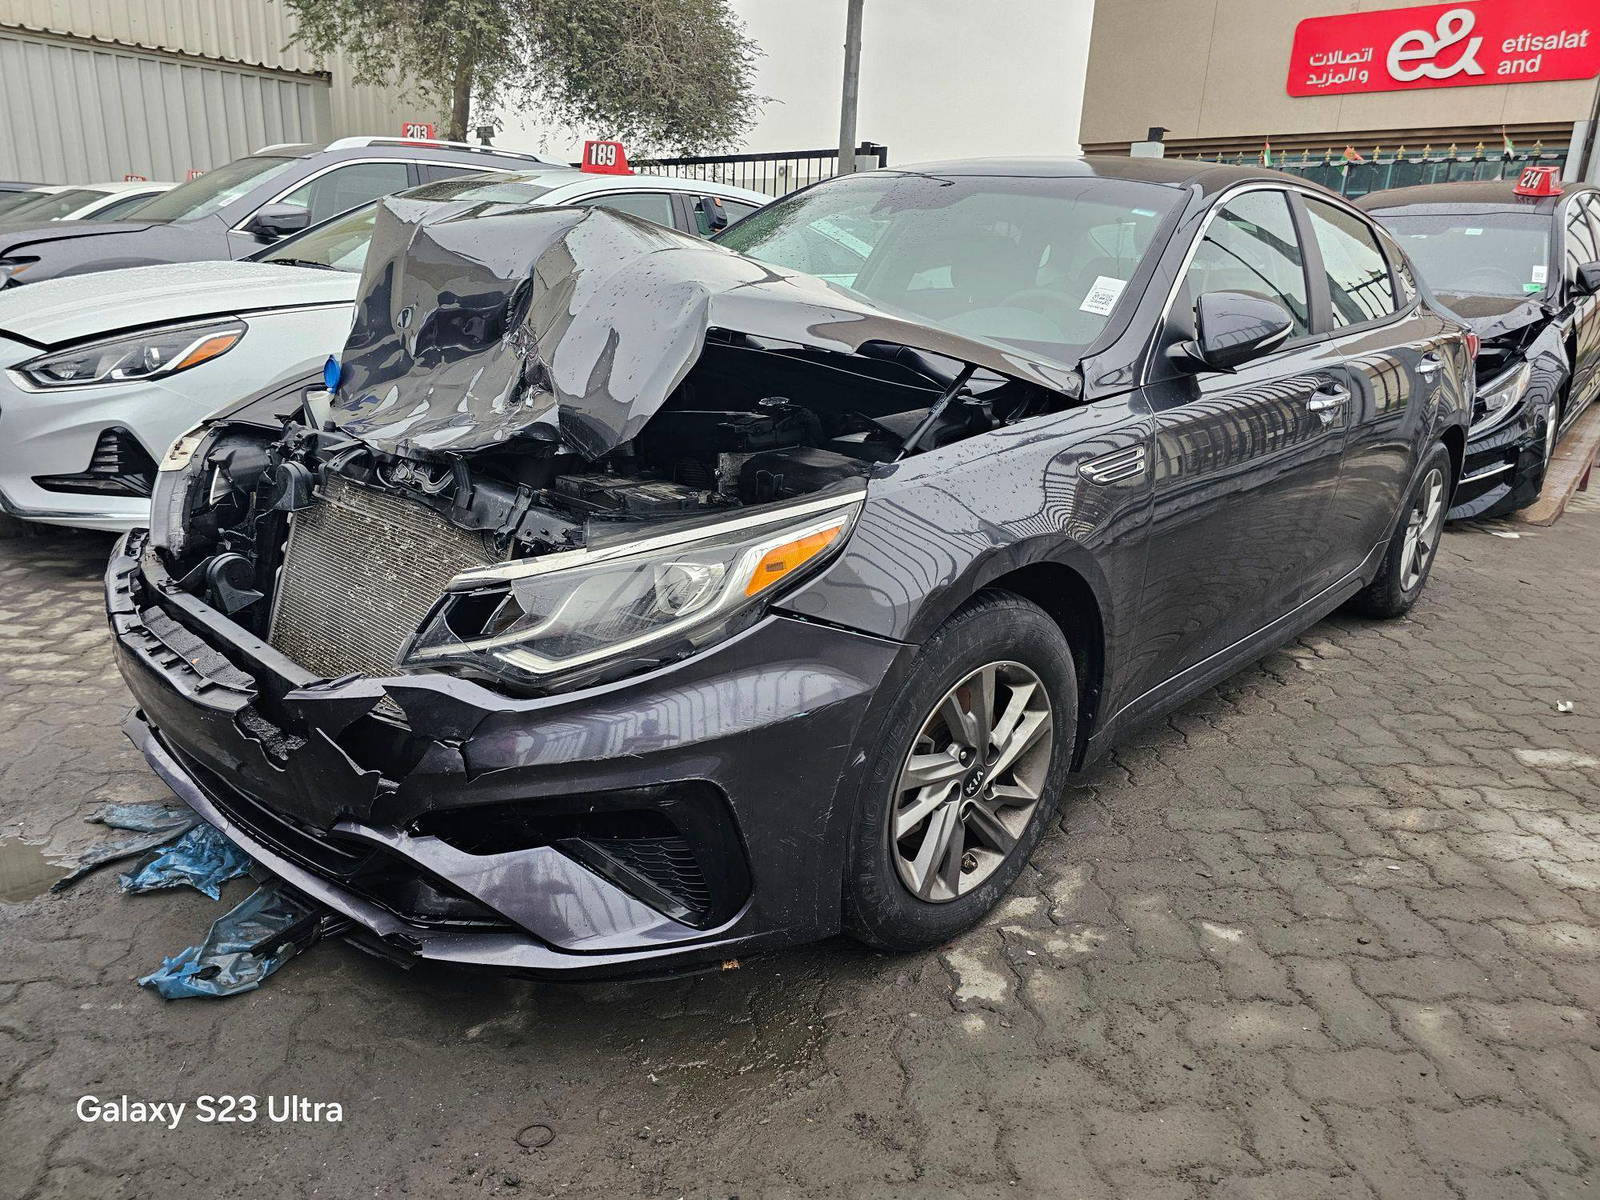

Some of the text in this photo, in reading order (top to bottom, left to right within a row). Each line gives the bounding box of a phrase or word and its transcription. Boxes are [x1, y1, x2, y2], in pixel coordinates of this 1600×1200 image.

[1501, 28, 1591, 53] etisalat
[1309, 47, 1373, 67] اتصالات
[1496, 53, 1542, 75] and
[407, 124, 428, 140] 203
[590, 143, 617, 167] 189
[1519, 169, 1543, 189] 214
[965, 770, 984, 794] KIA
